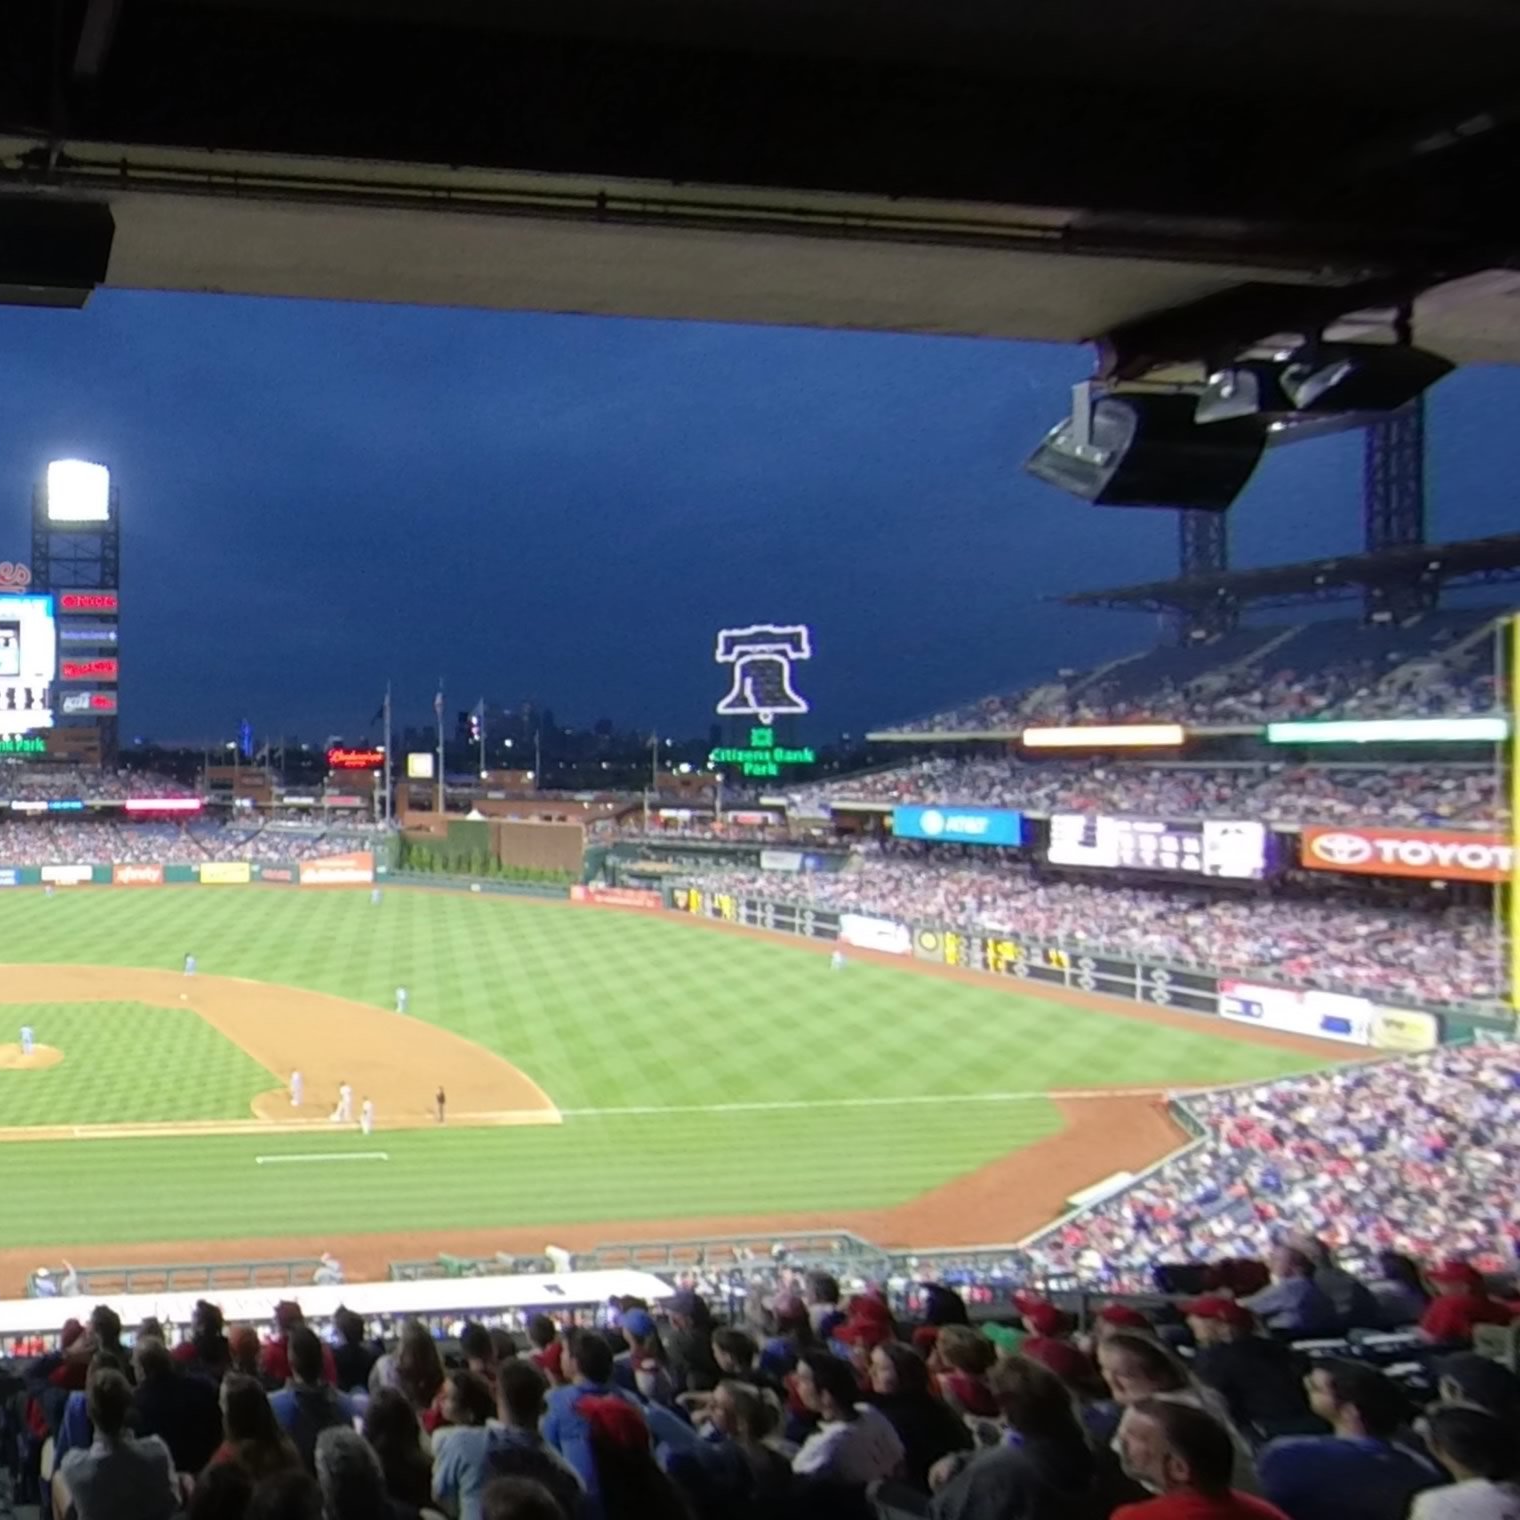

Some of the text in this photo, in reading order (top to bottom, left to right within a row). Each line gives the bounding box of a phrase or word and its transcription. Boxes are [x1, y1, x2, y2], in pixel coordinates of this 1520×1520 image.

[15, 735, 46, 753] Park
[711, 747, 815, 763] Citizens Bank
[743, 762, 779, 776] Park
